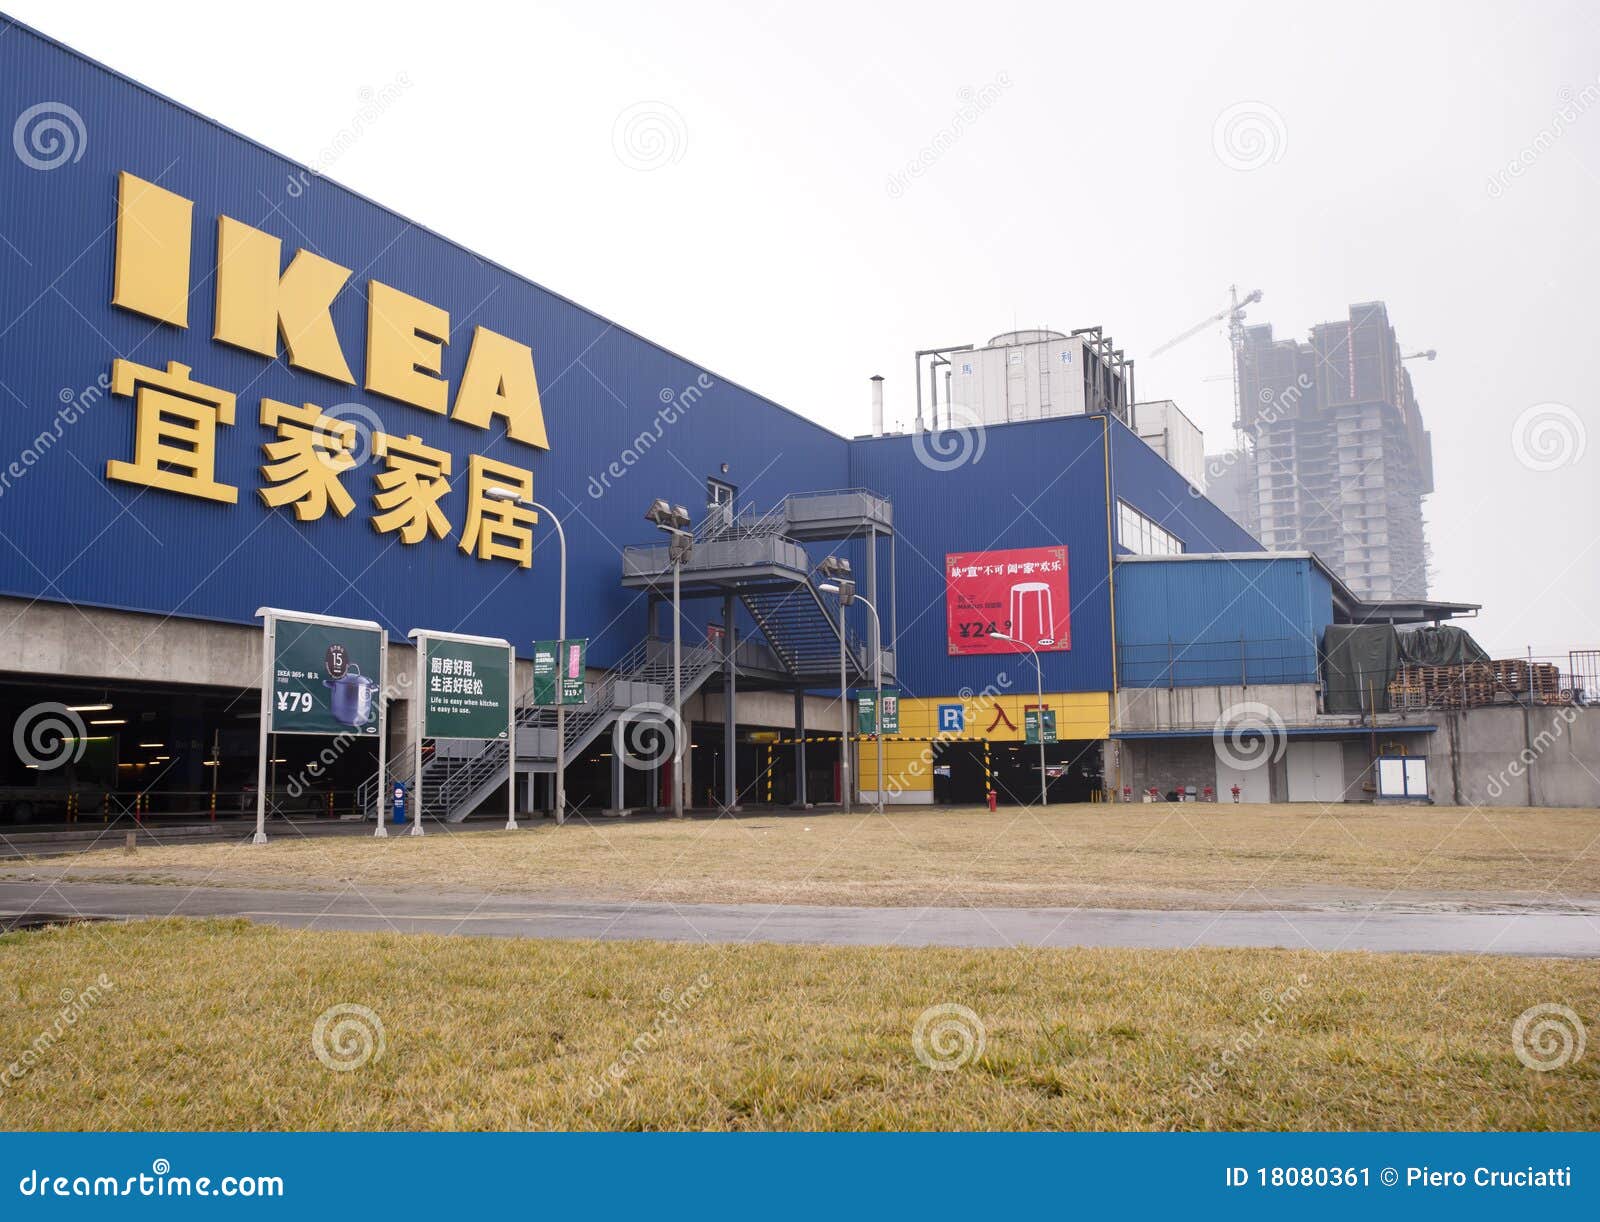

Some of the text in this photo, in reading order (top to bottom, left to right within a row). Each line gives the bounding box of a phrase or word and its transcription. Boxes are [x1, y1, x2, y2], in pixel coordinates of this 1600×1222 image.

[111, 170, 550, 451] IKEA
[106, 357, 539, 569] 宜家家居
[332, 652, 343, 666] 15
[431, 675, 483, 695] 生活好轻松
[277, 691, 313, 713] ¥79
[430, 696, 442, 704] Life
[449, 698, 463, 706] easy
[437, 706, 451, 714] easy
